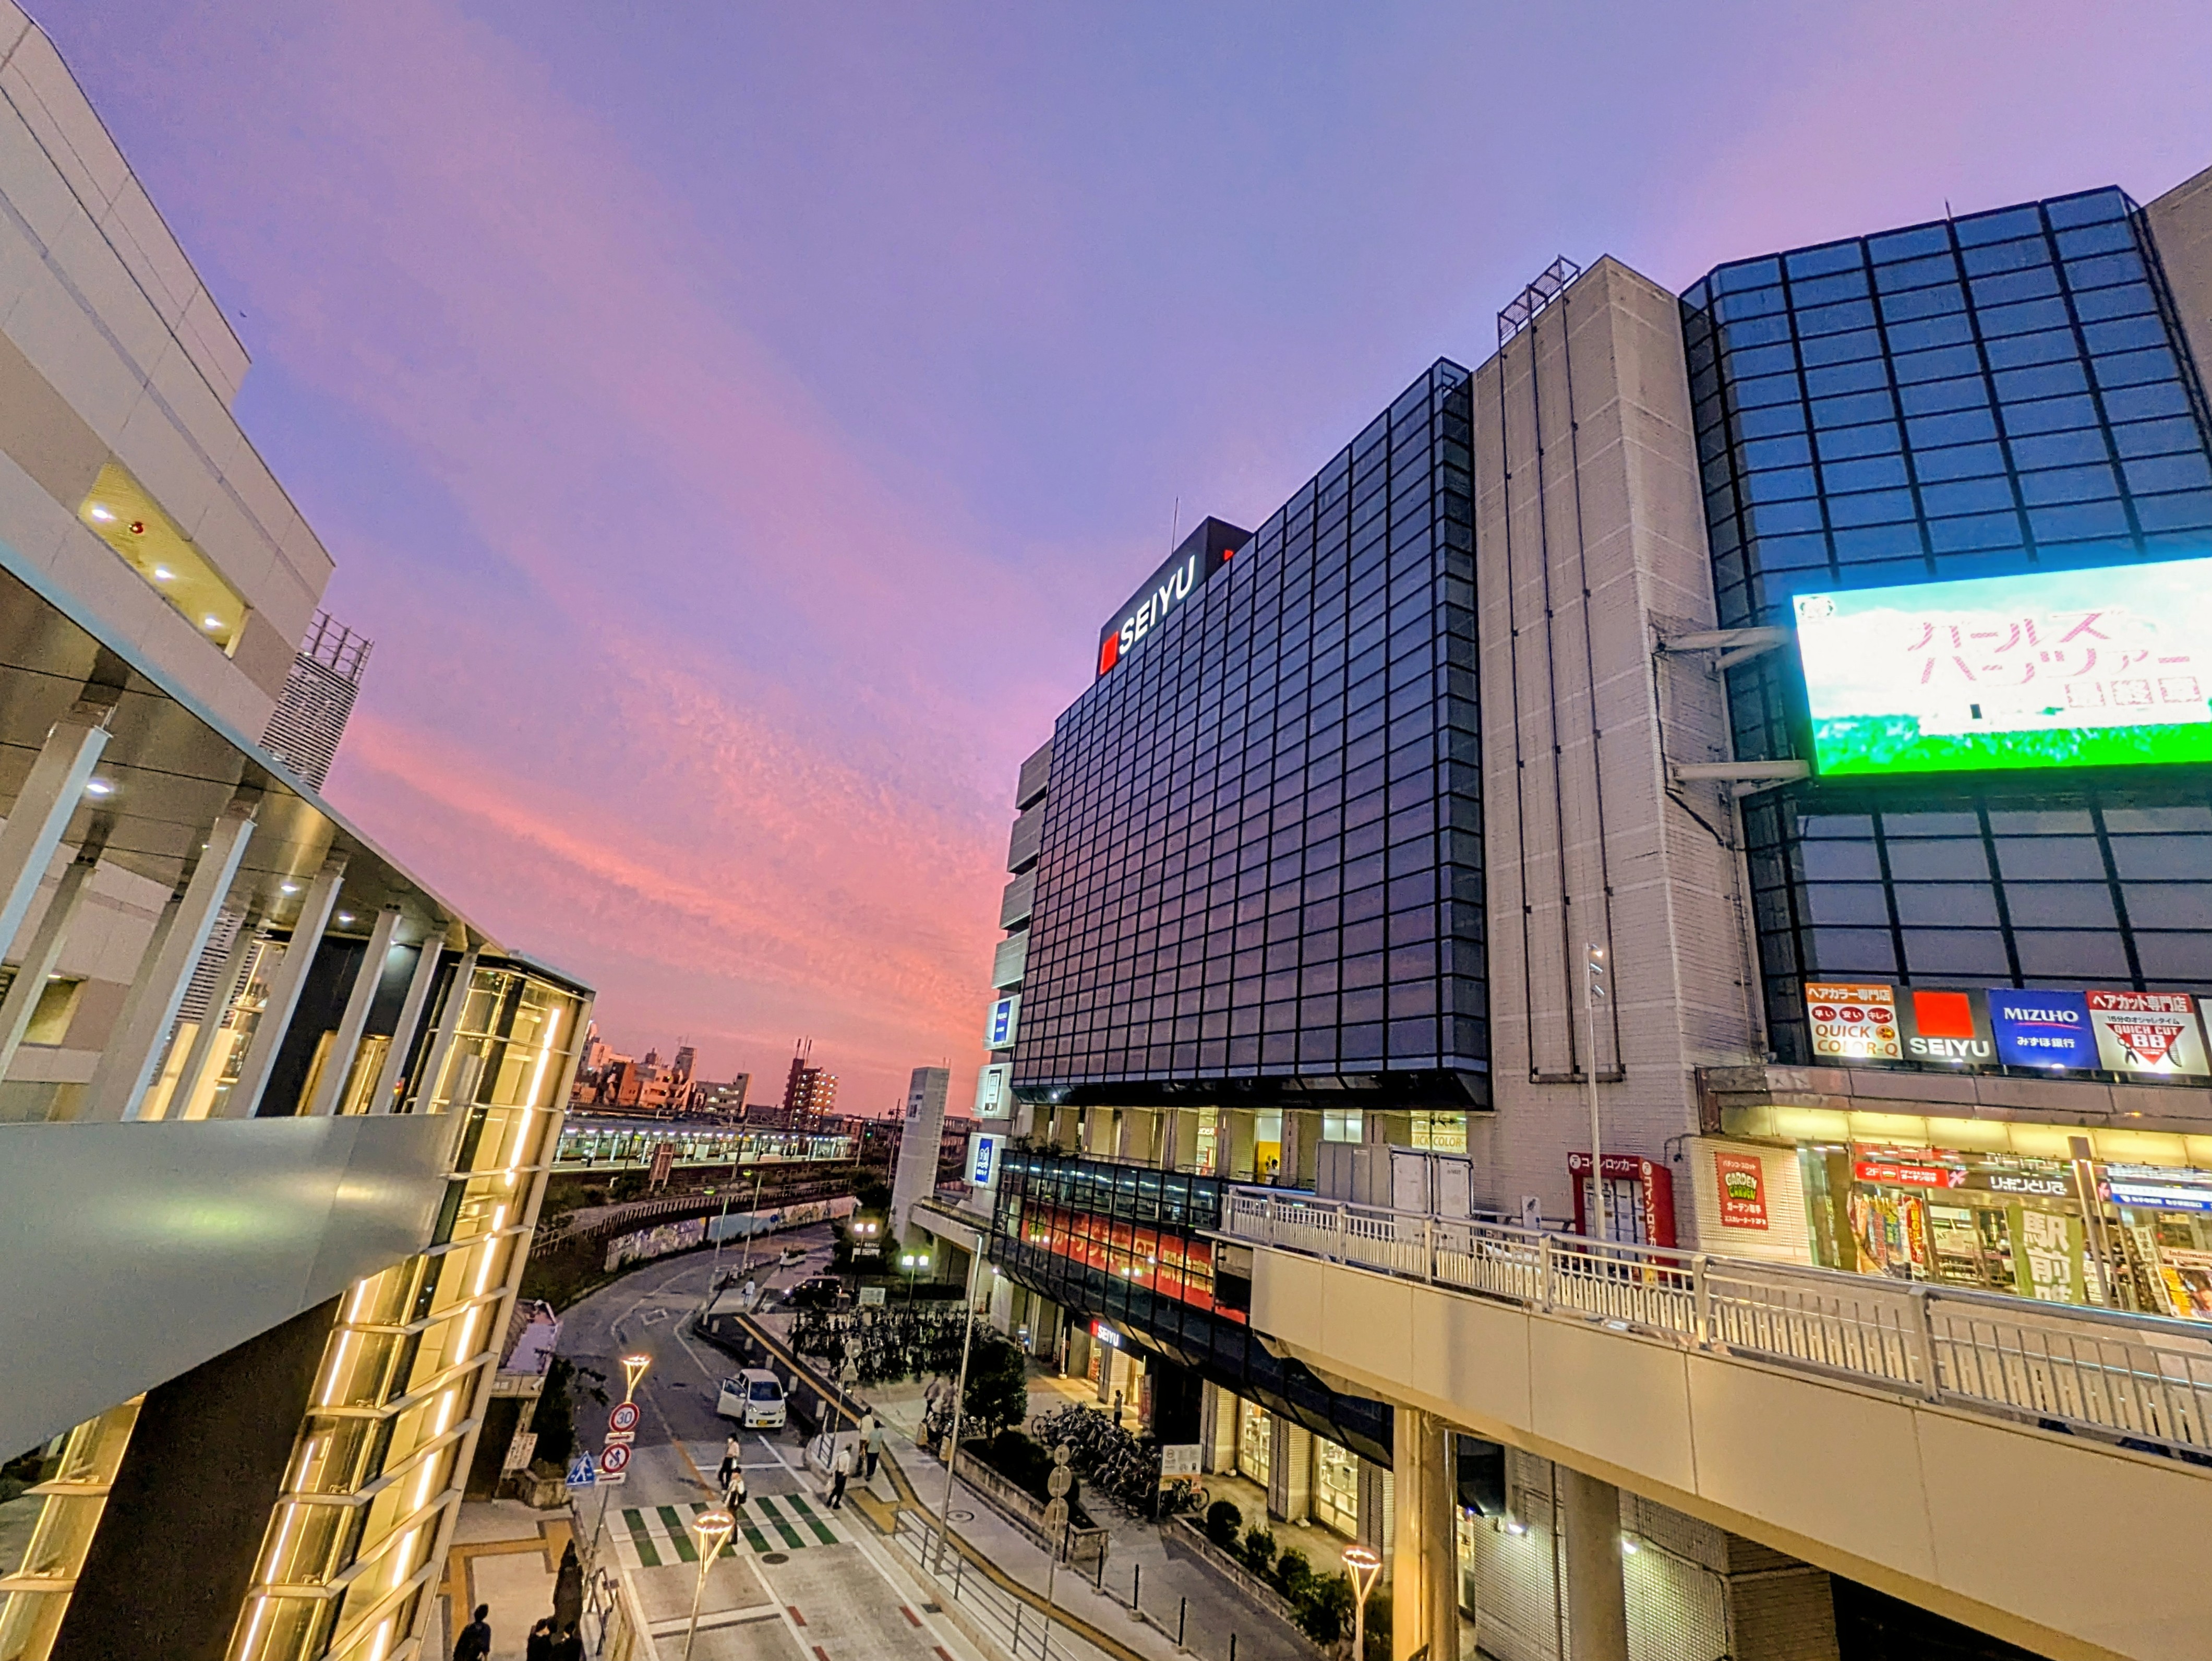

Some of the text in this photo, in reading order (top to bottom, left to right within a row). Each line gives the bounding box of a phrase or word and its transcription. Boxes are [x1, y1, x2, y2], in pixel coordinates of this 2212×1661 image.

[1119, 554, 1195, 654] SEIYU
[1808, 988, 1891, 1001] ヘアカラー専門店
[2092, 995, 2187, 1012] ヘアカット専門店
[1814, 1009, 1893, 1020] 早い 安い キレイ
[2004, 1007, 2079, 1023] MIZUHO
[1815, 1024, 1871, 1038] QUICK
[2154, 1026, 2178, 1036] CUT
[1909, 1037, 1990, 1057] SEIYU
[2017, 1036, 2075, 1048] みずほ銀行
[2131, 1034, 2166, 1048] BB
[1725, 1172, 1757, 1190] GARDEN
[1990, 1176, 2067, 1195] リボンとりで
[1097, 1325, 1120, 1347] SEIYU
[616, 1411, 632, 1425] 30
